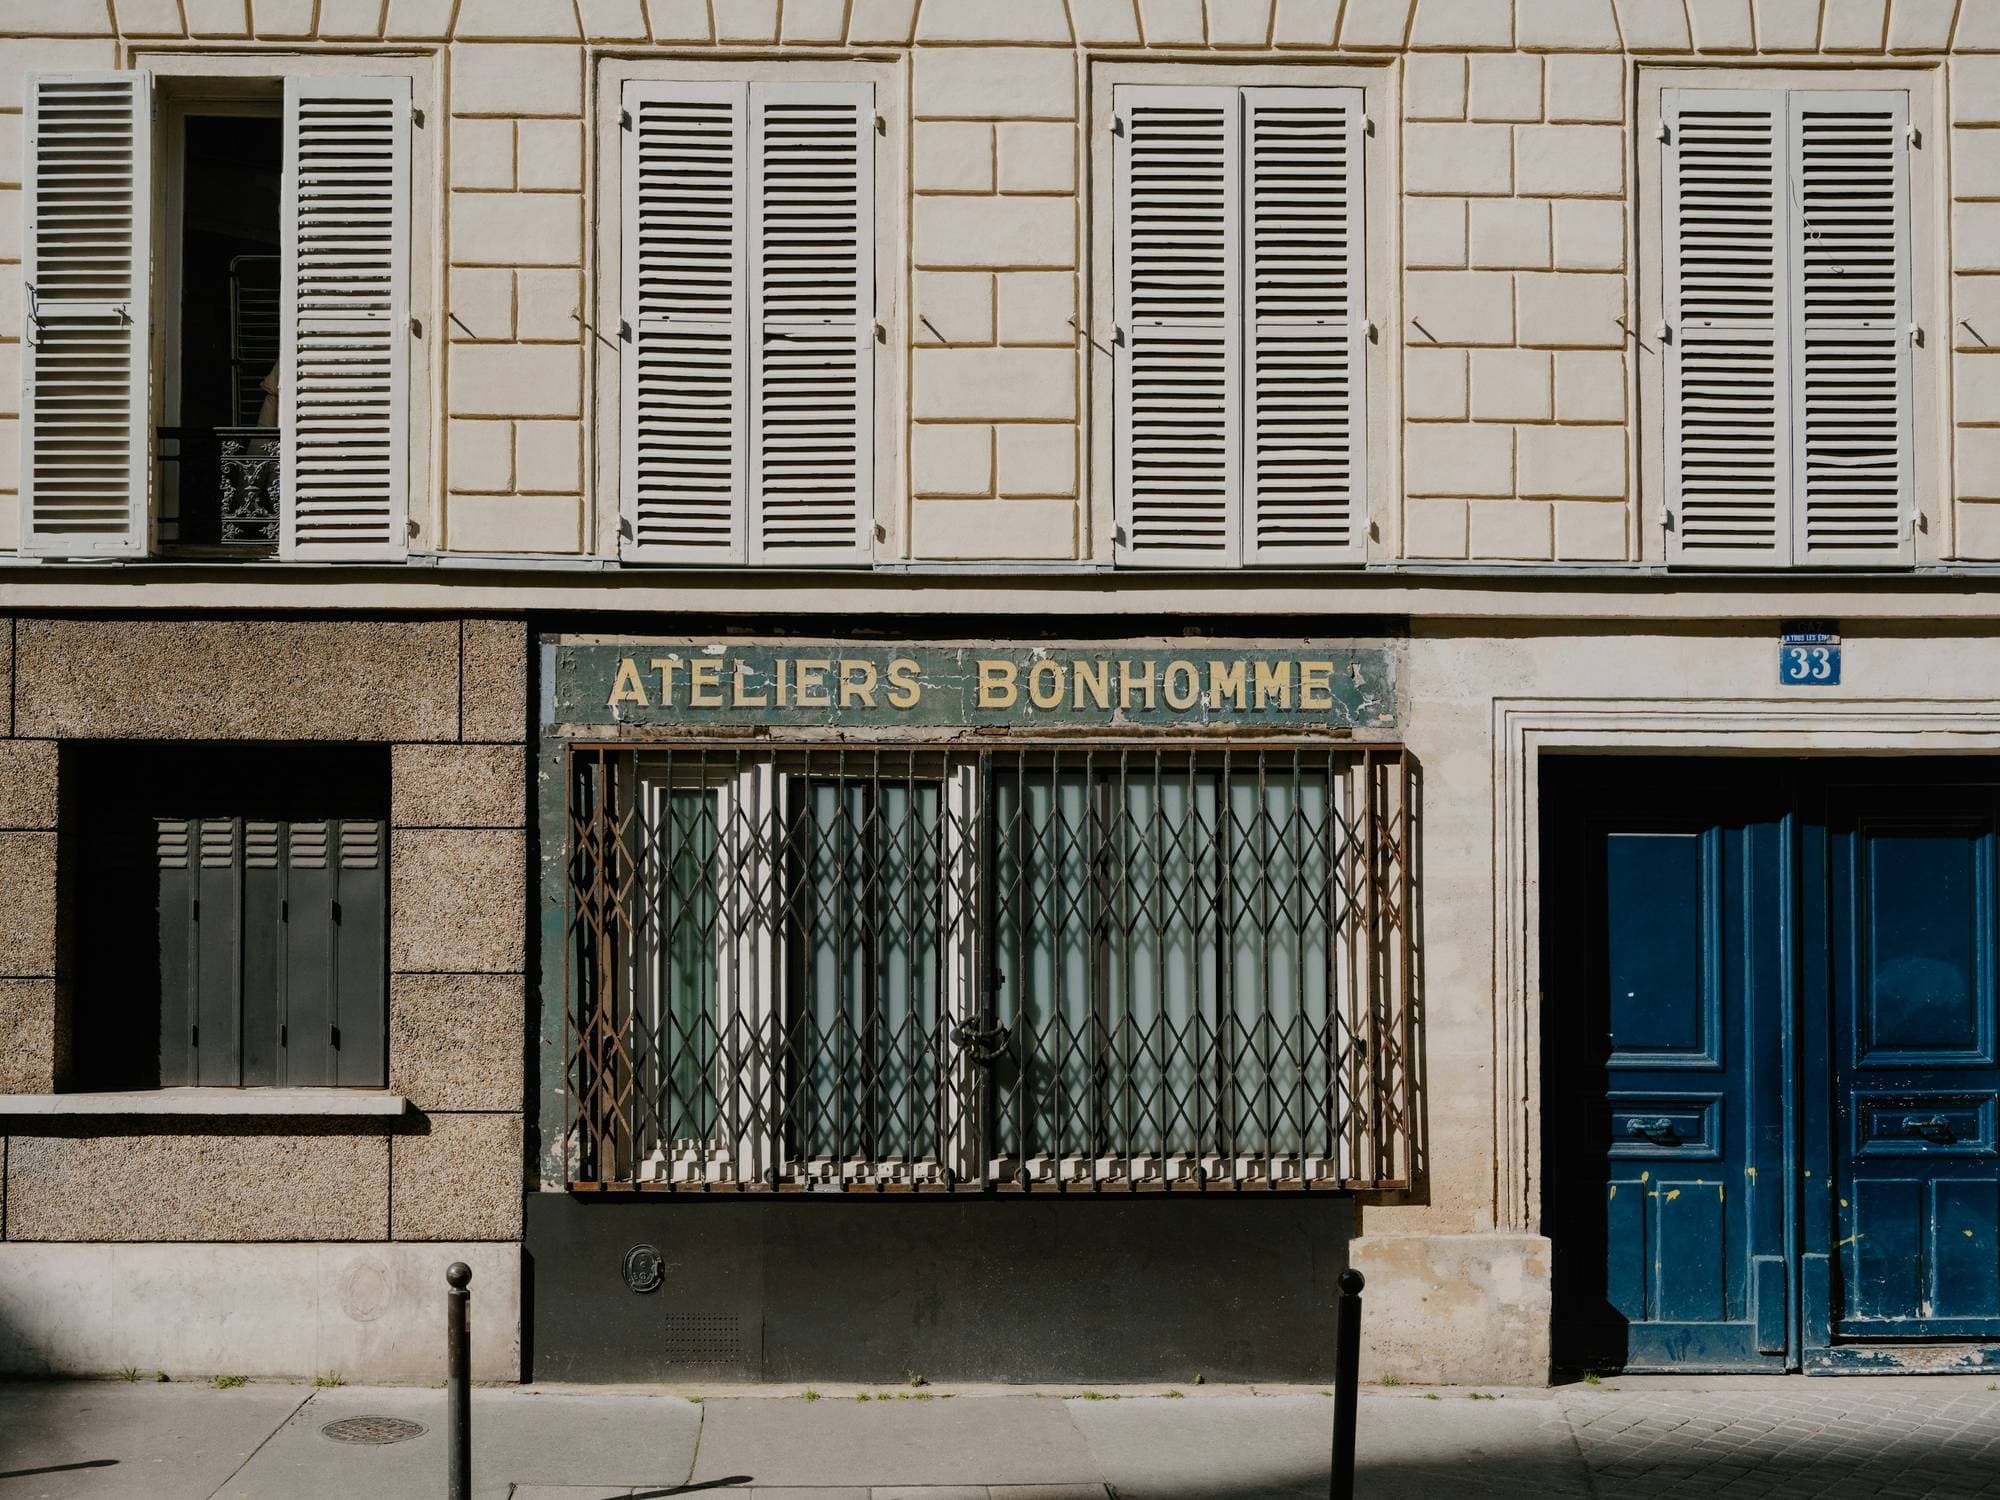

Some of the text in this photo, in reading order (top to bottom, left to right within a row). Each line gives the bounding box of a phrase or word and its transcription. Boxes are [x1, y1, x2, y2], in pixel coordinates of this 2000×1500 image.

[606, 657, 1334, 711] ATELIERS BONHOMME
[1790, 647, 1832, 679] 33
